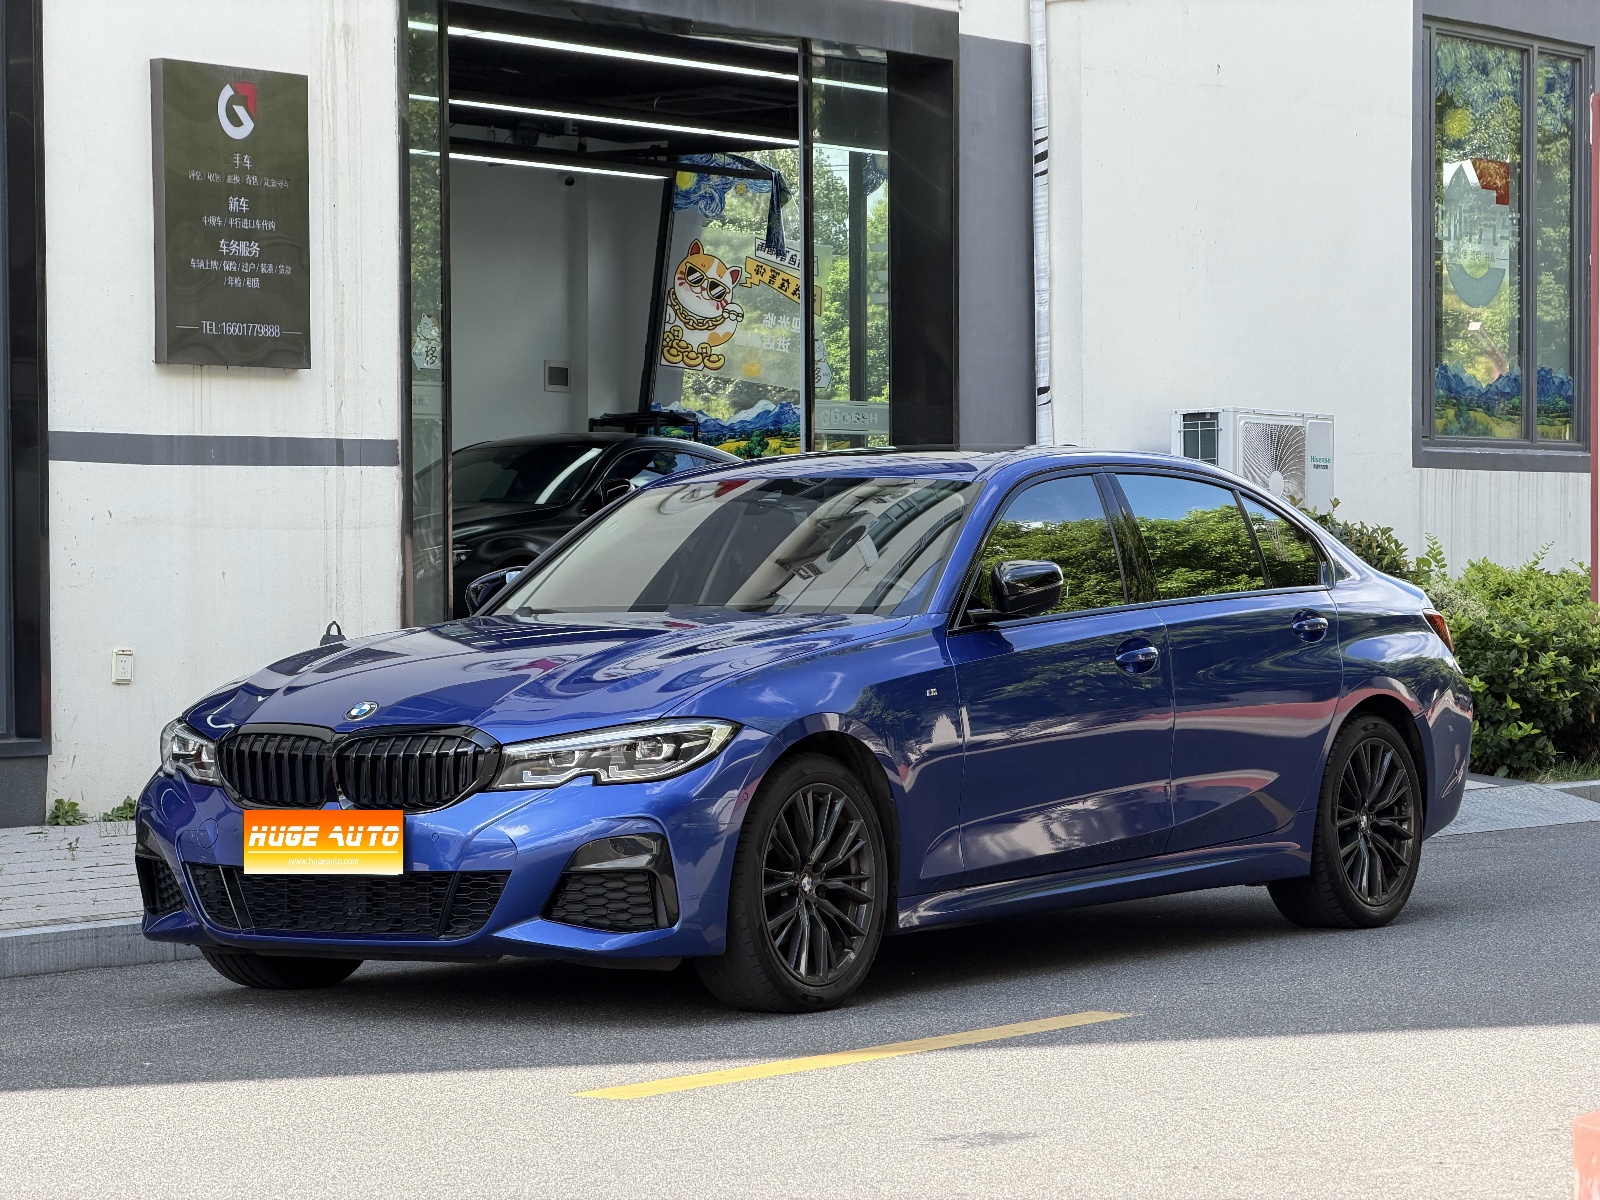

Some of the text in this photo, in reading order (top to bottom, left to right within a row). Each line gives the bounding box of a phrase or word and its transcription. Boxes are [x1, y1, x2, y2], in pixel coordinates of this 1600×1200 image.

[228, 196, 250, 213] 新车
[219, 239, 260, 257] 车务服务
[201, 320, 280, 338] TEL:16601779888
[425, 345, 438, 365] 移
[1310, 455, 1331, 464] Hisense
